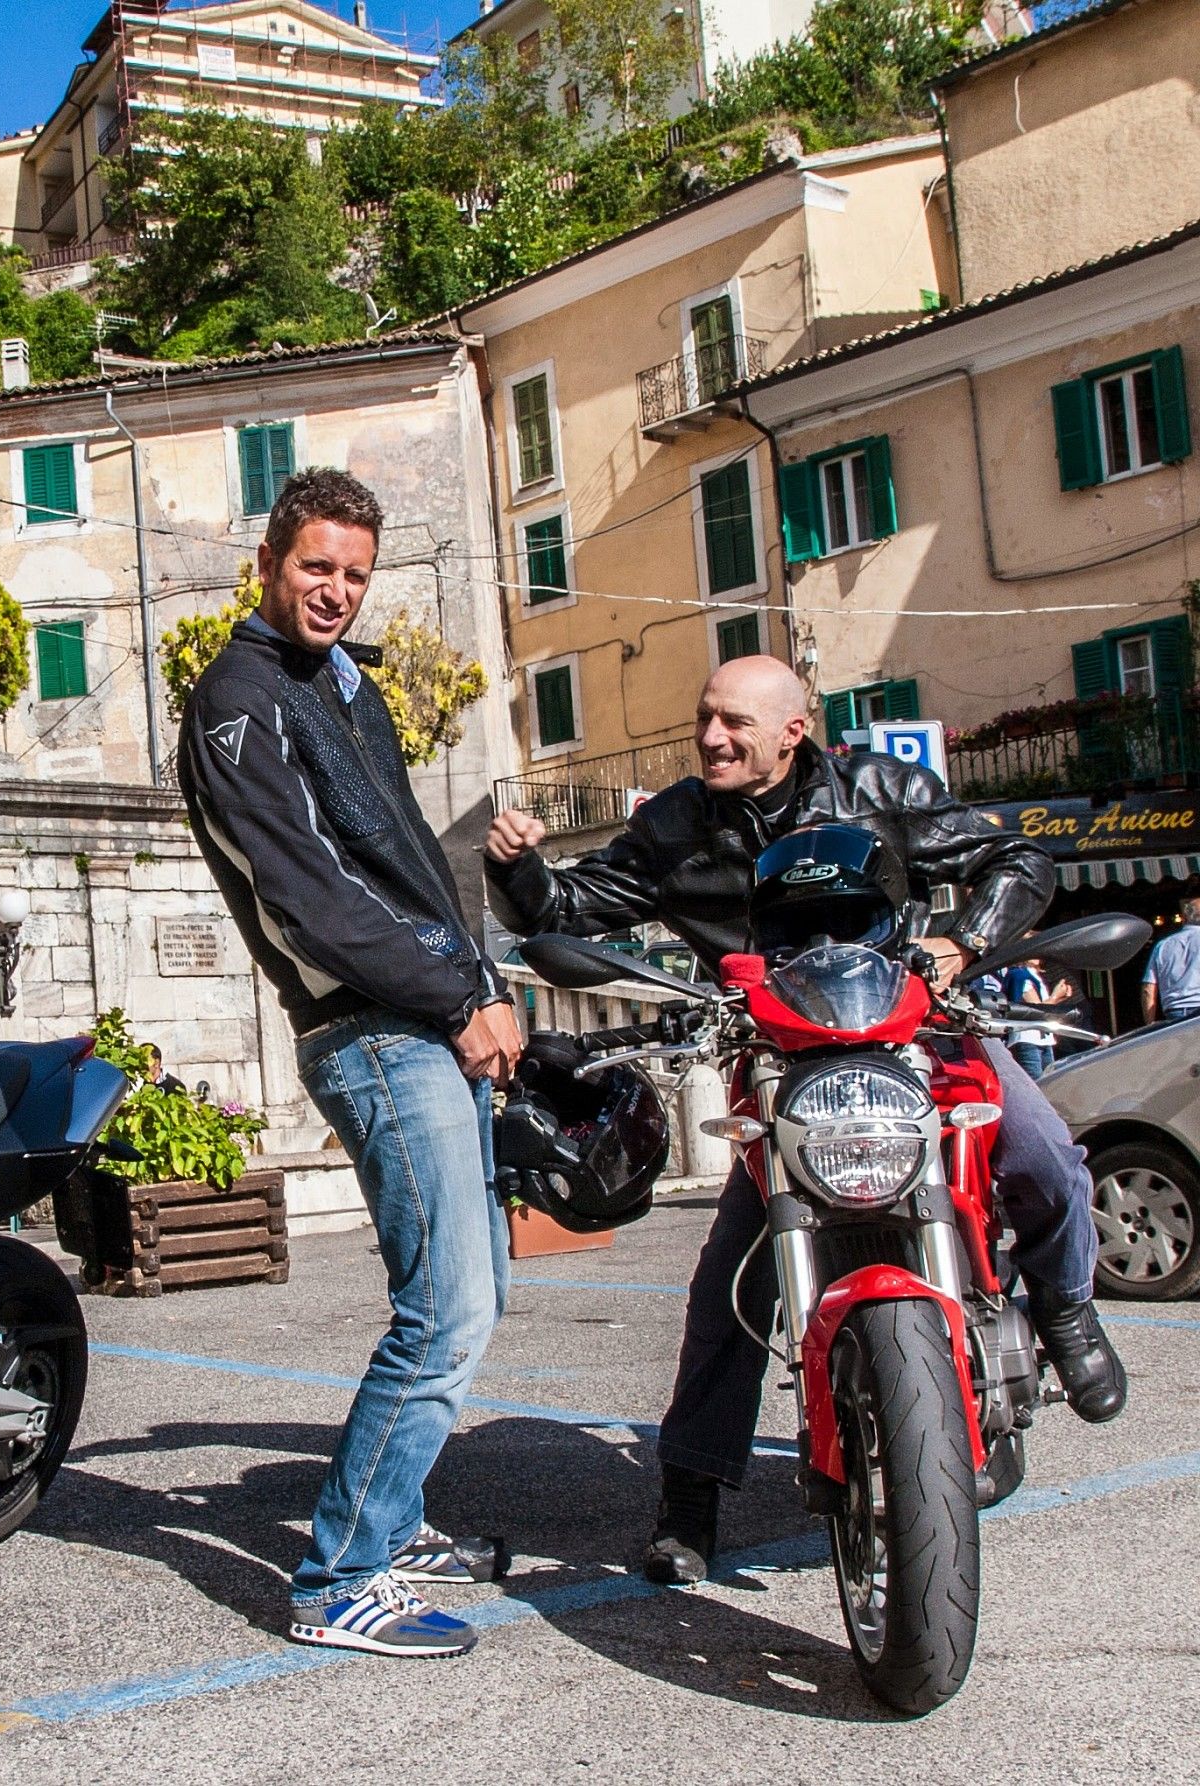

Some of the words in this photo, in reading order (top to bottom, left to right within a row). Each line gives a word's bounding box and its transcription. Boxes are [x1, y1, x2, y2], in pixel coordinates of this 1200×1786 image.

[893, 736, 921, 763] P
[1019, 806, 1079, 837] Bar
[1089, 801, 1195, 835] Aniene
[1075, 836, 1144, 851] Gelateria
[789, 867, 830, 880] HJC
[626, 1082, 642, 1117] SHARK
